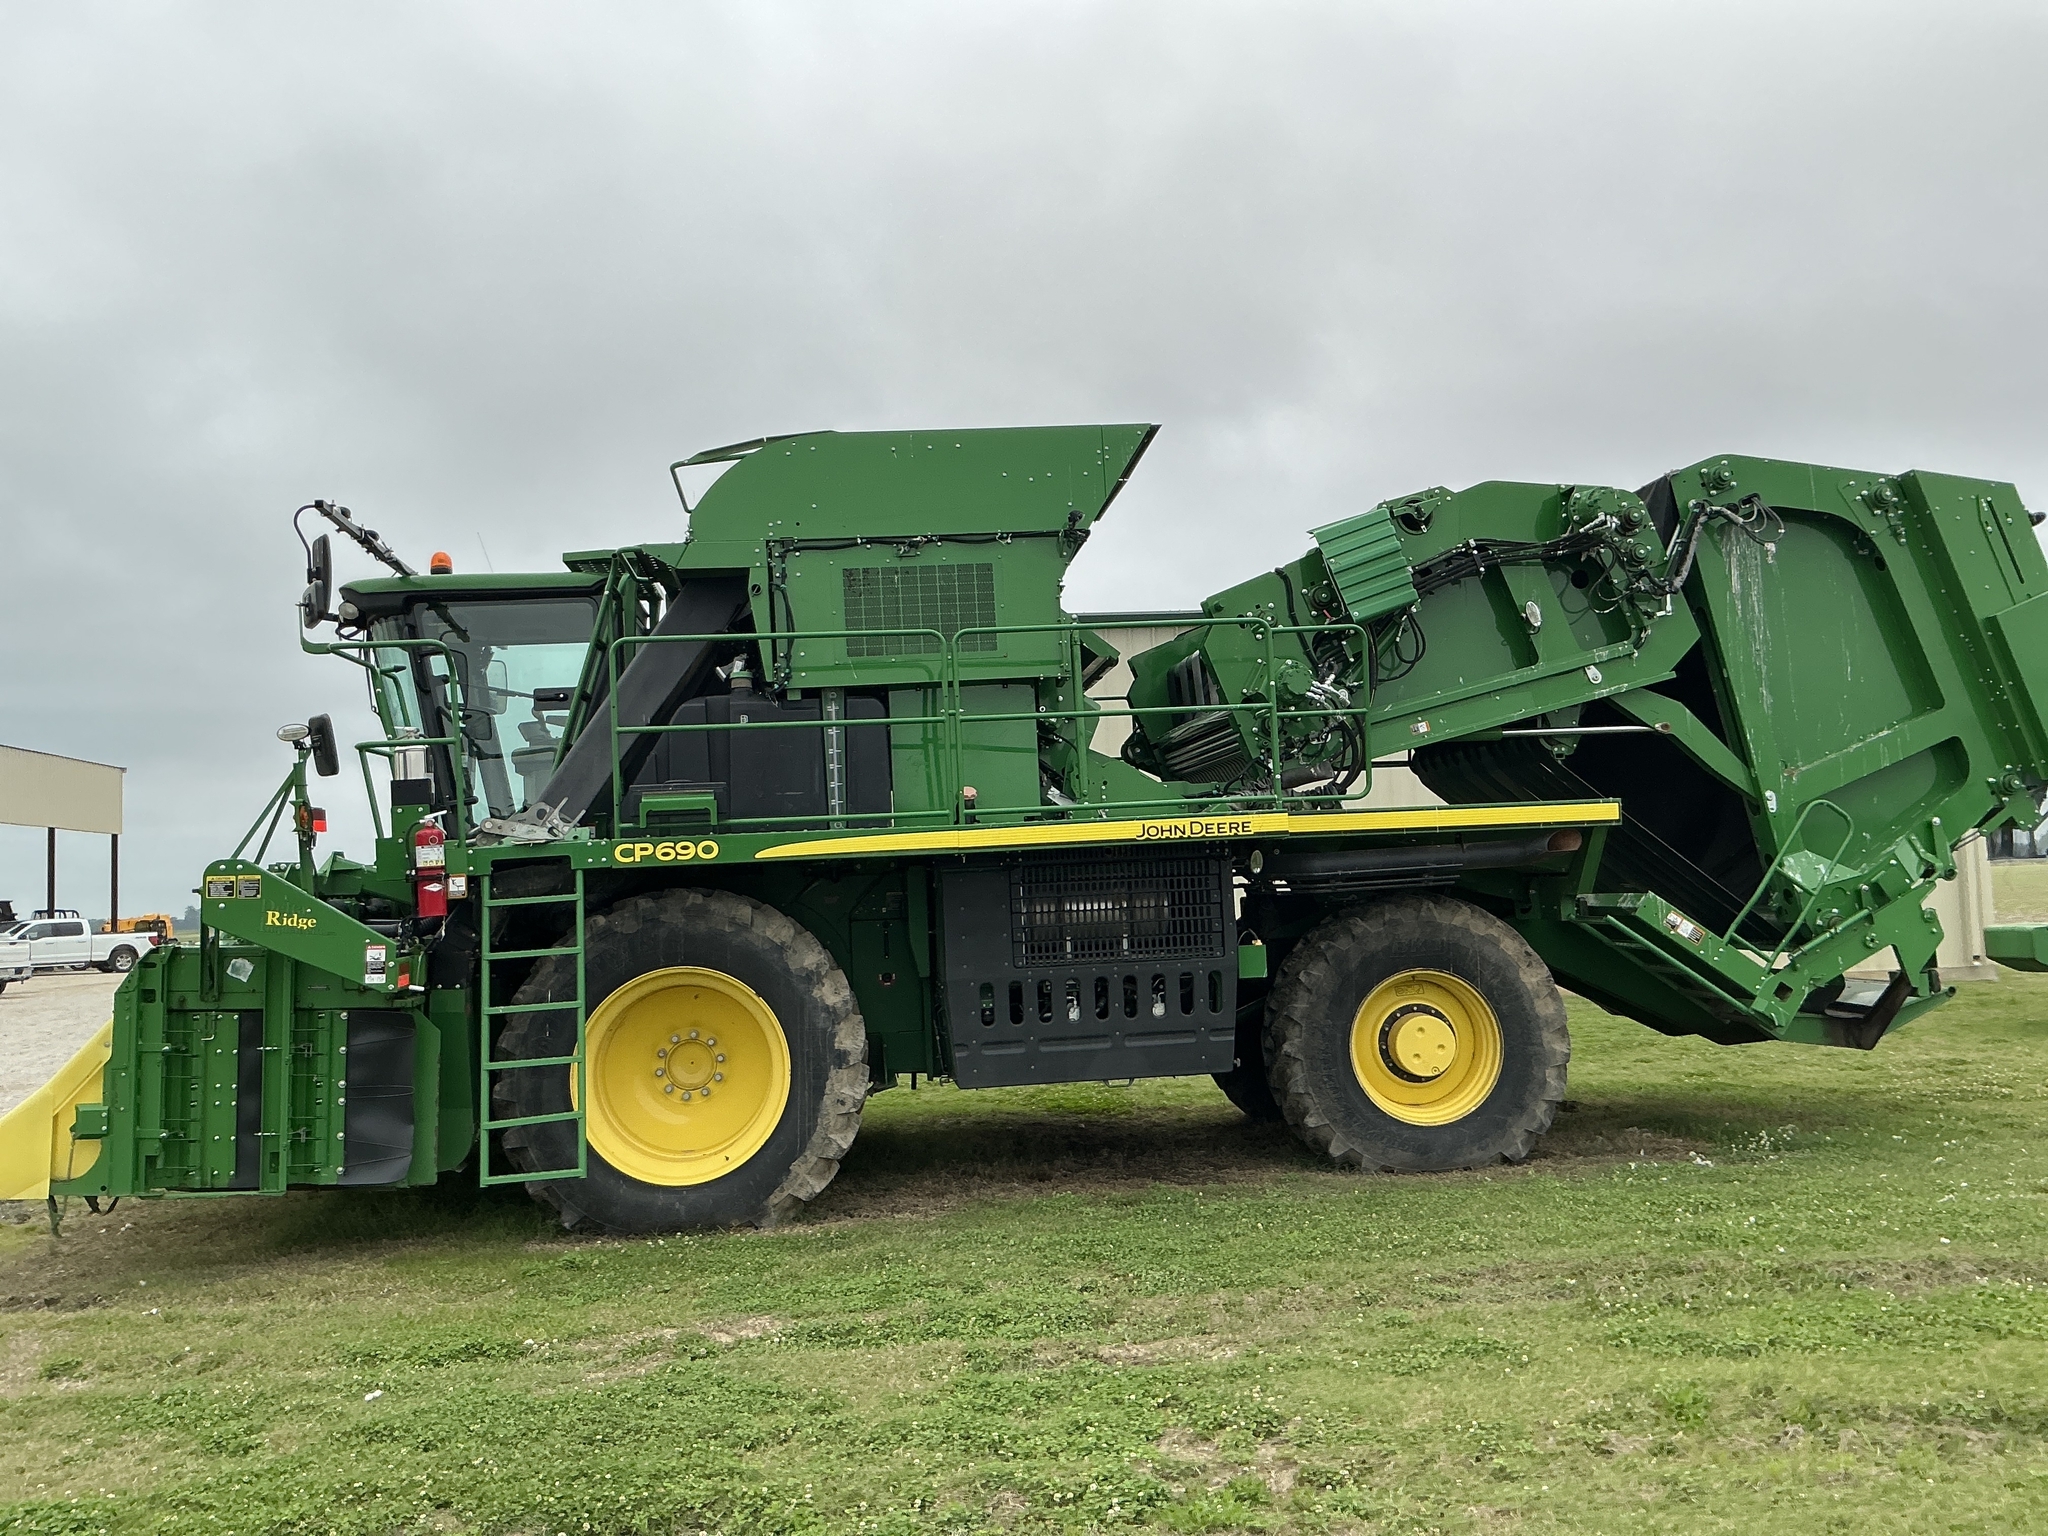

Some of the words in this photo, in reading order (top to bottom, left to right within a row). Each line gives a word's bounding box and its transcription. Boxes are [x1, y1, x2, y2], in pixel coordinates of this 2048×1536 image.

[1136, 823, 1186, 839] JOHN
[1189, 821, 1252, 836] DEERE
[614, 840, 720, 863] CP690
[265, 910, 317, 930] Ridge
